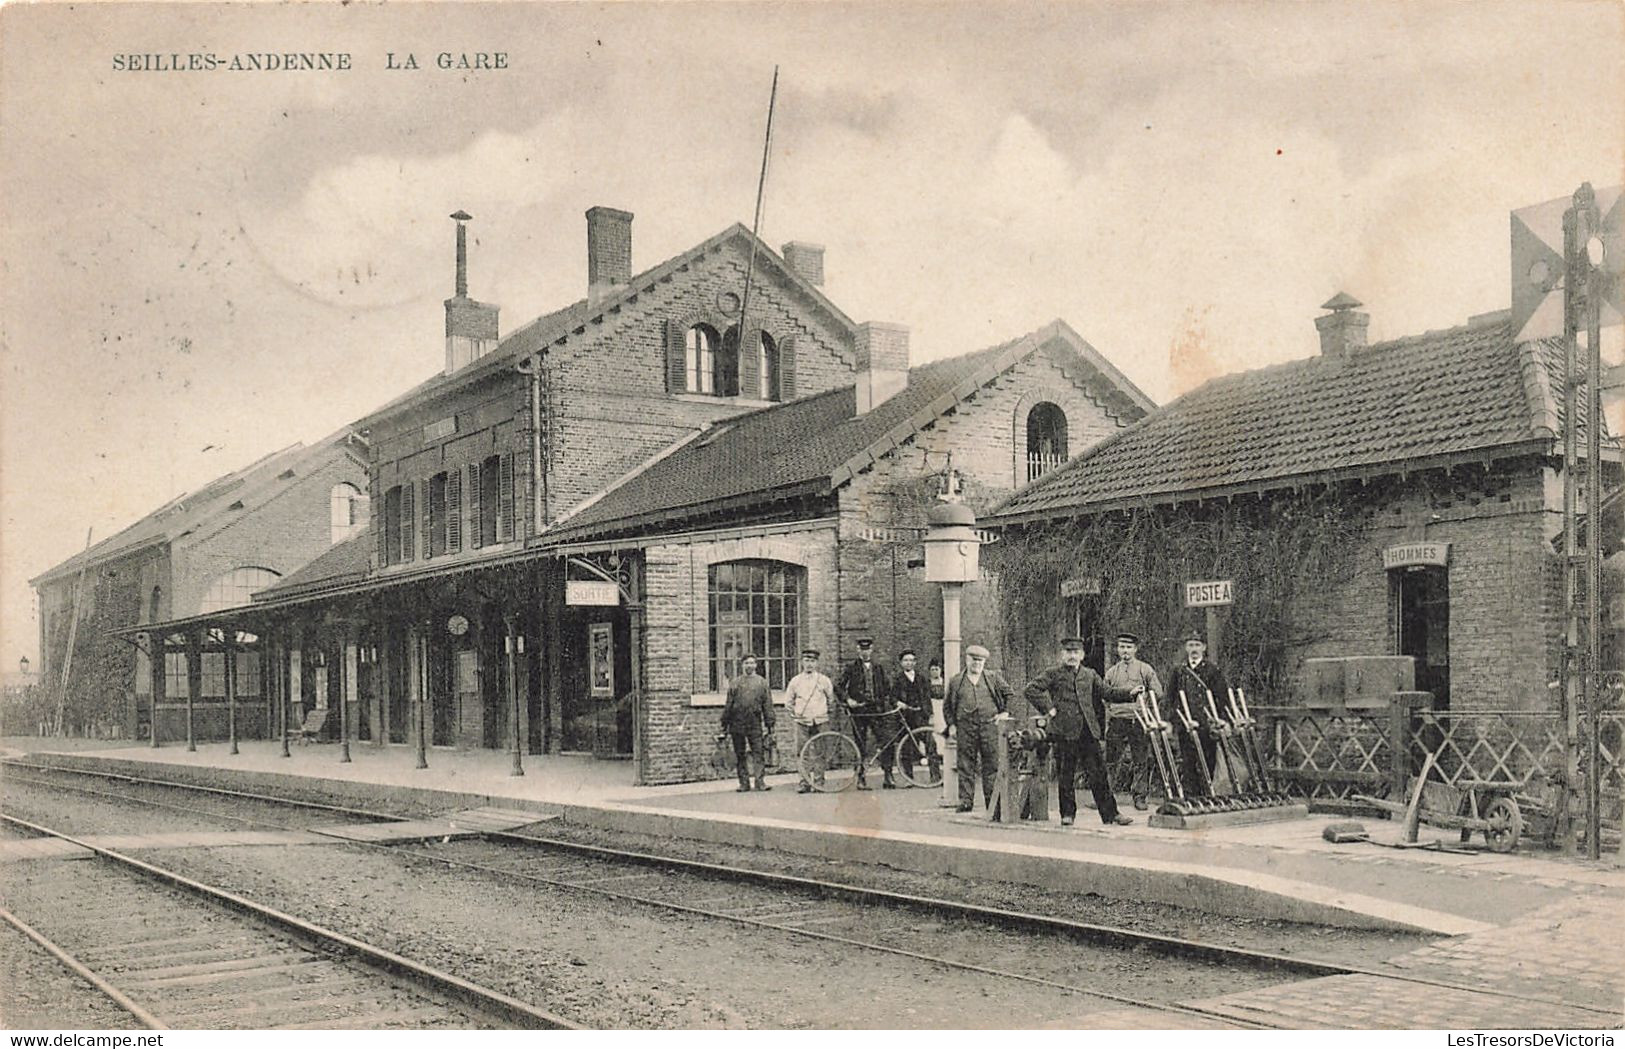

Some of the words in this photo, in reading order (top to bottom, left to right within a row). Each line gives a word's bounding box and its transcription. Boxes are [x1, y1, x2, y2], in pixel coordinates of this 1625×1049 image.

[1391, 547, 1437, 563] HOMMES
[1189, 584, 1221, 602] POSTE
[1222, 583, 1230, 601] A
